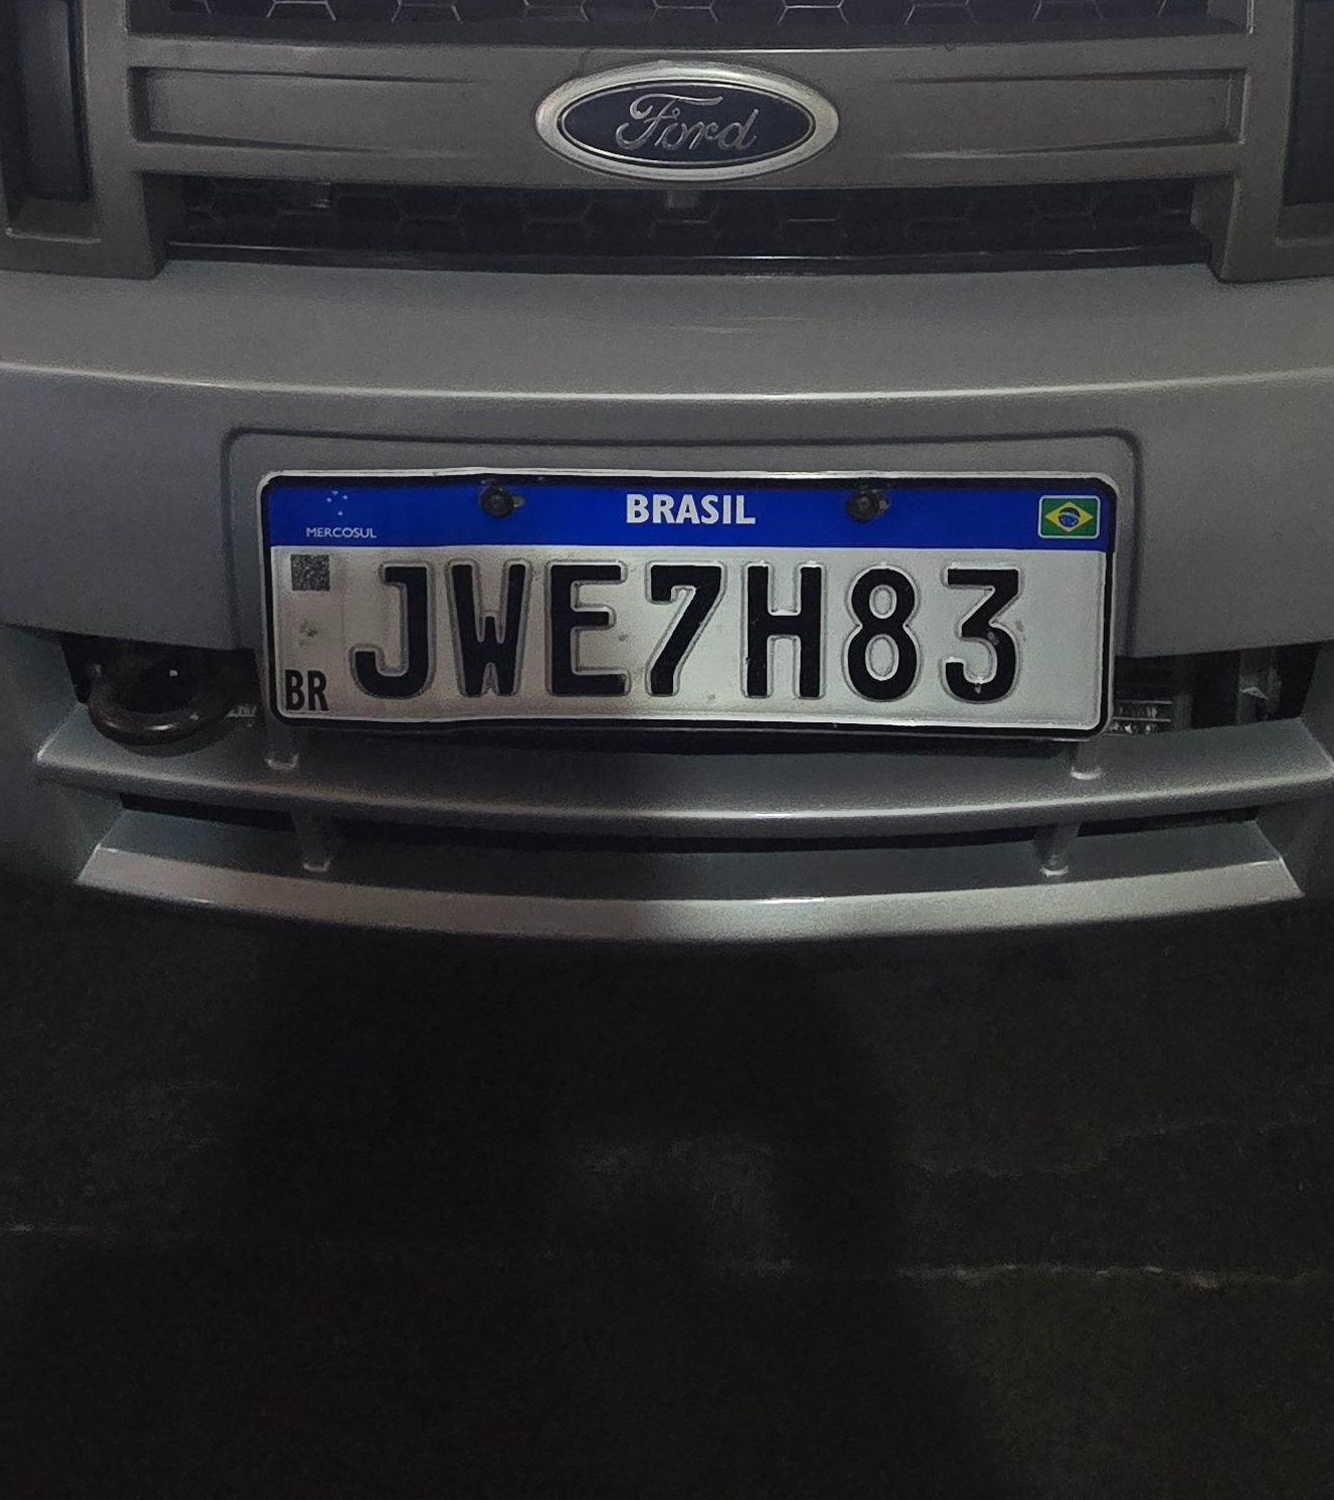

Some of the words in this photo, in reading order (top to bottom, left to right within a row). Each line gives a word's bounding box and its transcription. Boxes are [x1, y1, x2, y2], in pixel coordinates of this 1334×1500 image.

[615, 93, 759, 150] Ford
[626, 493, 756, 525] BRASIL
[306, 526, 378, 539] MERCOSUL
[352, 562, 1023, 702] JWE7H83
[284, 669, 330, 712] BR
